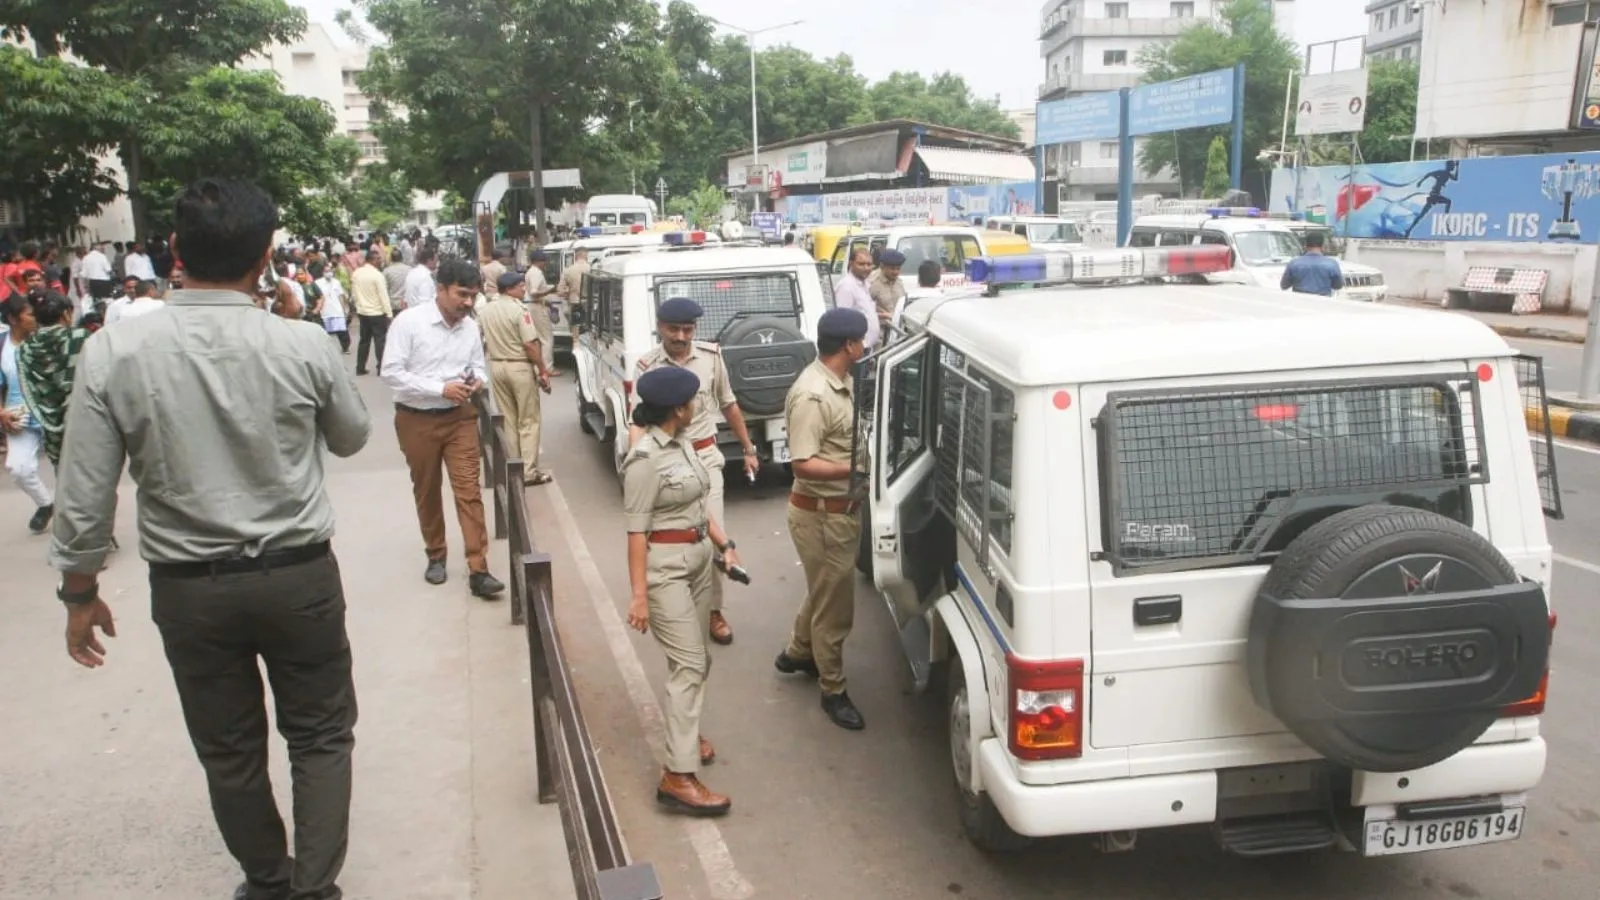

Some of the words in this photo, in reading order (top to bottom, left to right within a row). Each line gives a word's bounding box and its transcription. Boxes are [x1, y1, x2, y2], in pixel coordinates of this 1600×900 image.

[1506, 212, 1540, 238] ITS
[1365, 641, 1480, 671] BOLERO
[1383, 813, 1519, 848] GJ18GB6194
